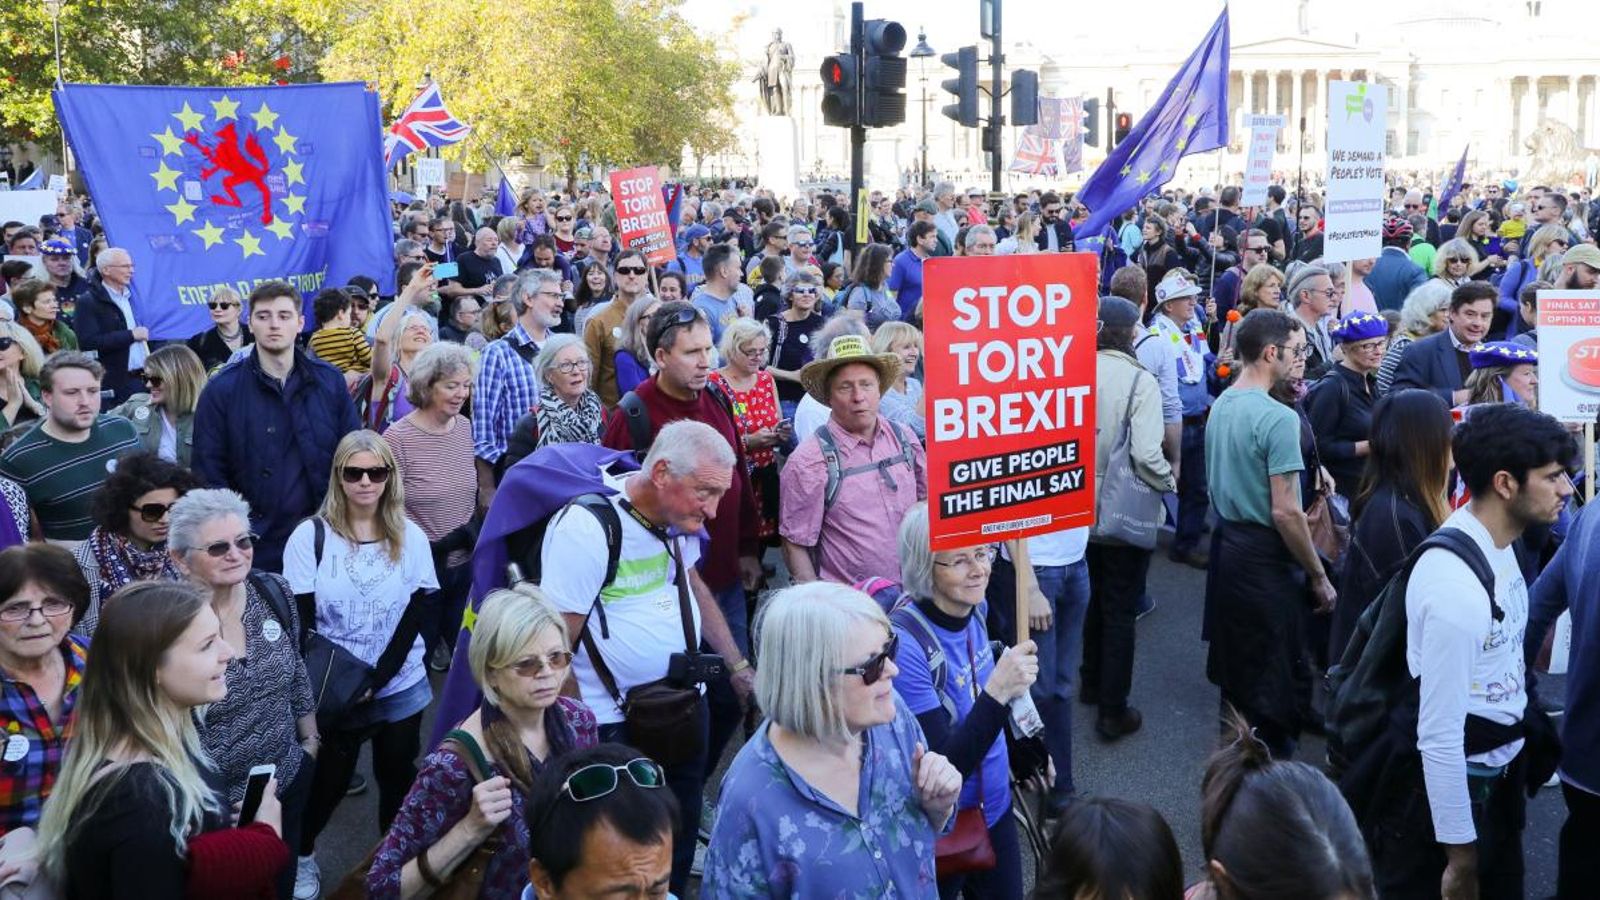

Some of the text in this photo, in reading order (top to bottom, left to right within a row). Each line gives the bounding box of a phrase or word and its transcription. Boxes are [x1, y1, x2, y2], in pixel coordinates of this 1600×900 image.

[1332, 149, 1382, 162] WE DEMAND A
[1331, 166, 1383, 179] PEOPLE'S VOTE
[620, 178, 652, 195] STOP
[622, 195, 656, 214] TORY
[621, 212, 666, 234] BREXIT
[952, 283, 1071, 331] STOP
[1547, 302, 1575, 310] FINAL
[1547, 315, 1586, 323] OPTION
[949, 335, 1073, 385] TORY
[934, 385, 1090, 442] BREXIT
[953, 443, 1076, 483] GIVE PEOPLE
[944, 469, 1084, 514] THE FINAL SAY
